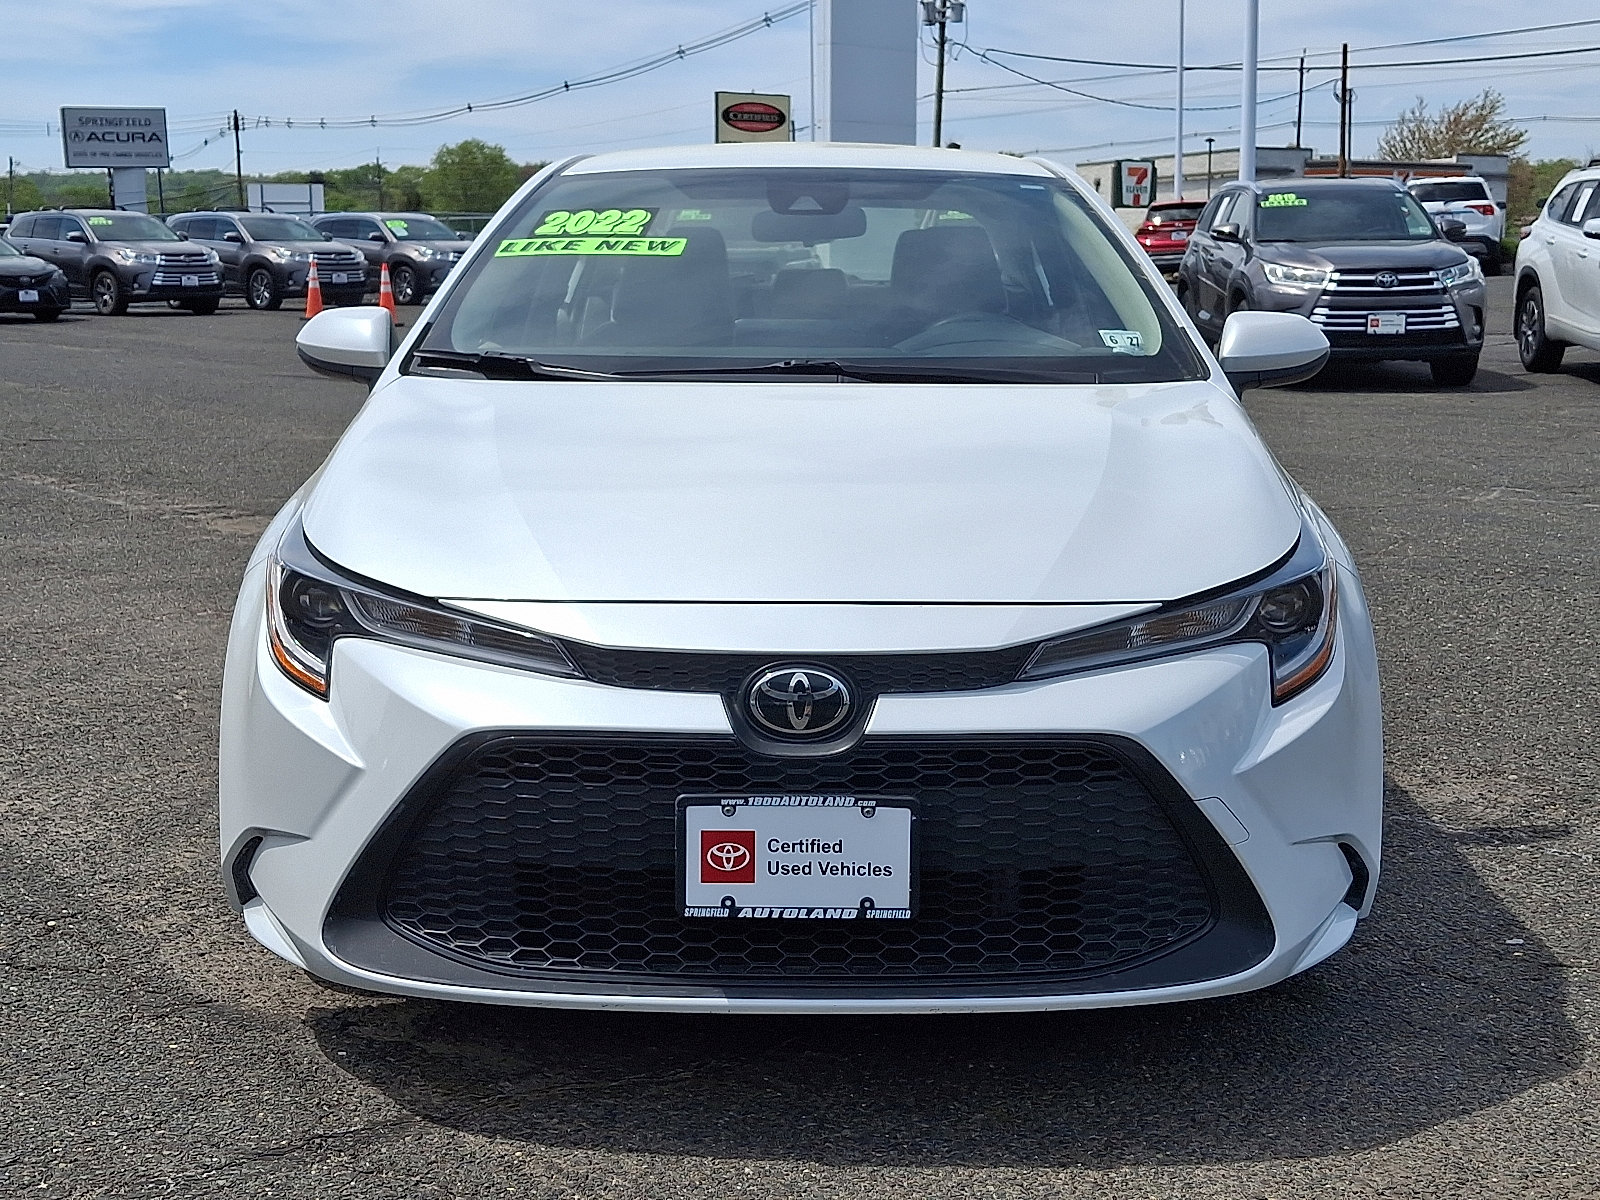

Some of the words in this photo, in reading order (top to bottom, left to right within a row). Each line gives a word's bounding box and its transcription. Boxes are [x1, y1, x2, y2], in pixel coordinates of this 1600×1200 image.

[78, 116, 151, 127] SPRINGFIELD
[86, 131, 162, 142] ACURA
[534, 209, 651, 235] 2022
[500, 240, 586, 253] LIKE
[595, 240, 680, 252] NEW
[1109, 335, 1118, 344] 6
[1126, 336, 1140, 347] 27
[767, 838, 843, 854] Certified
[767, 861, 812, 876] Used
[818, 861, 893, 877] Vehicles
[684, 908, 730, 917] SPRINGFIELD
[738, 908, 858, 919] AUTOLAND
[866, 909, 911, 919] SPRINGFIELD
